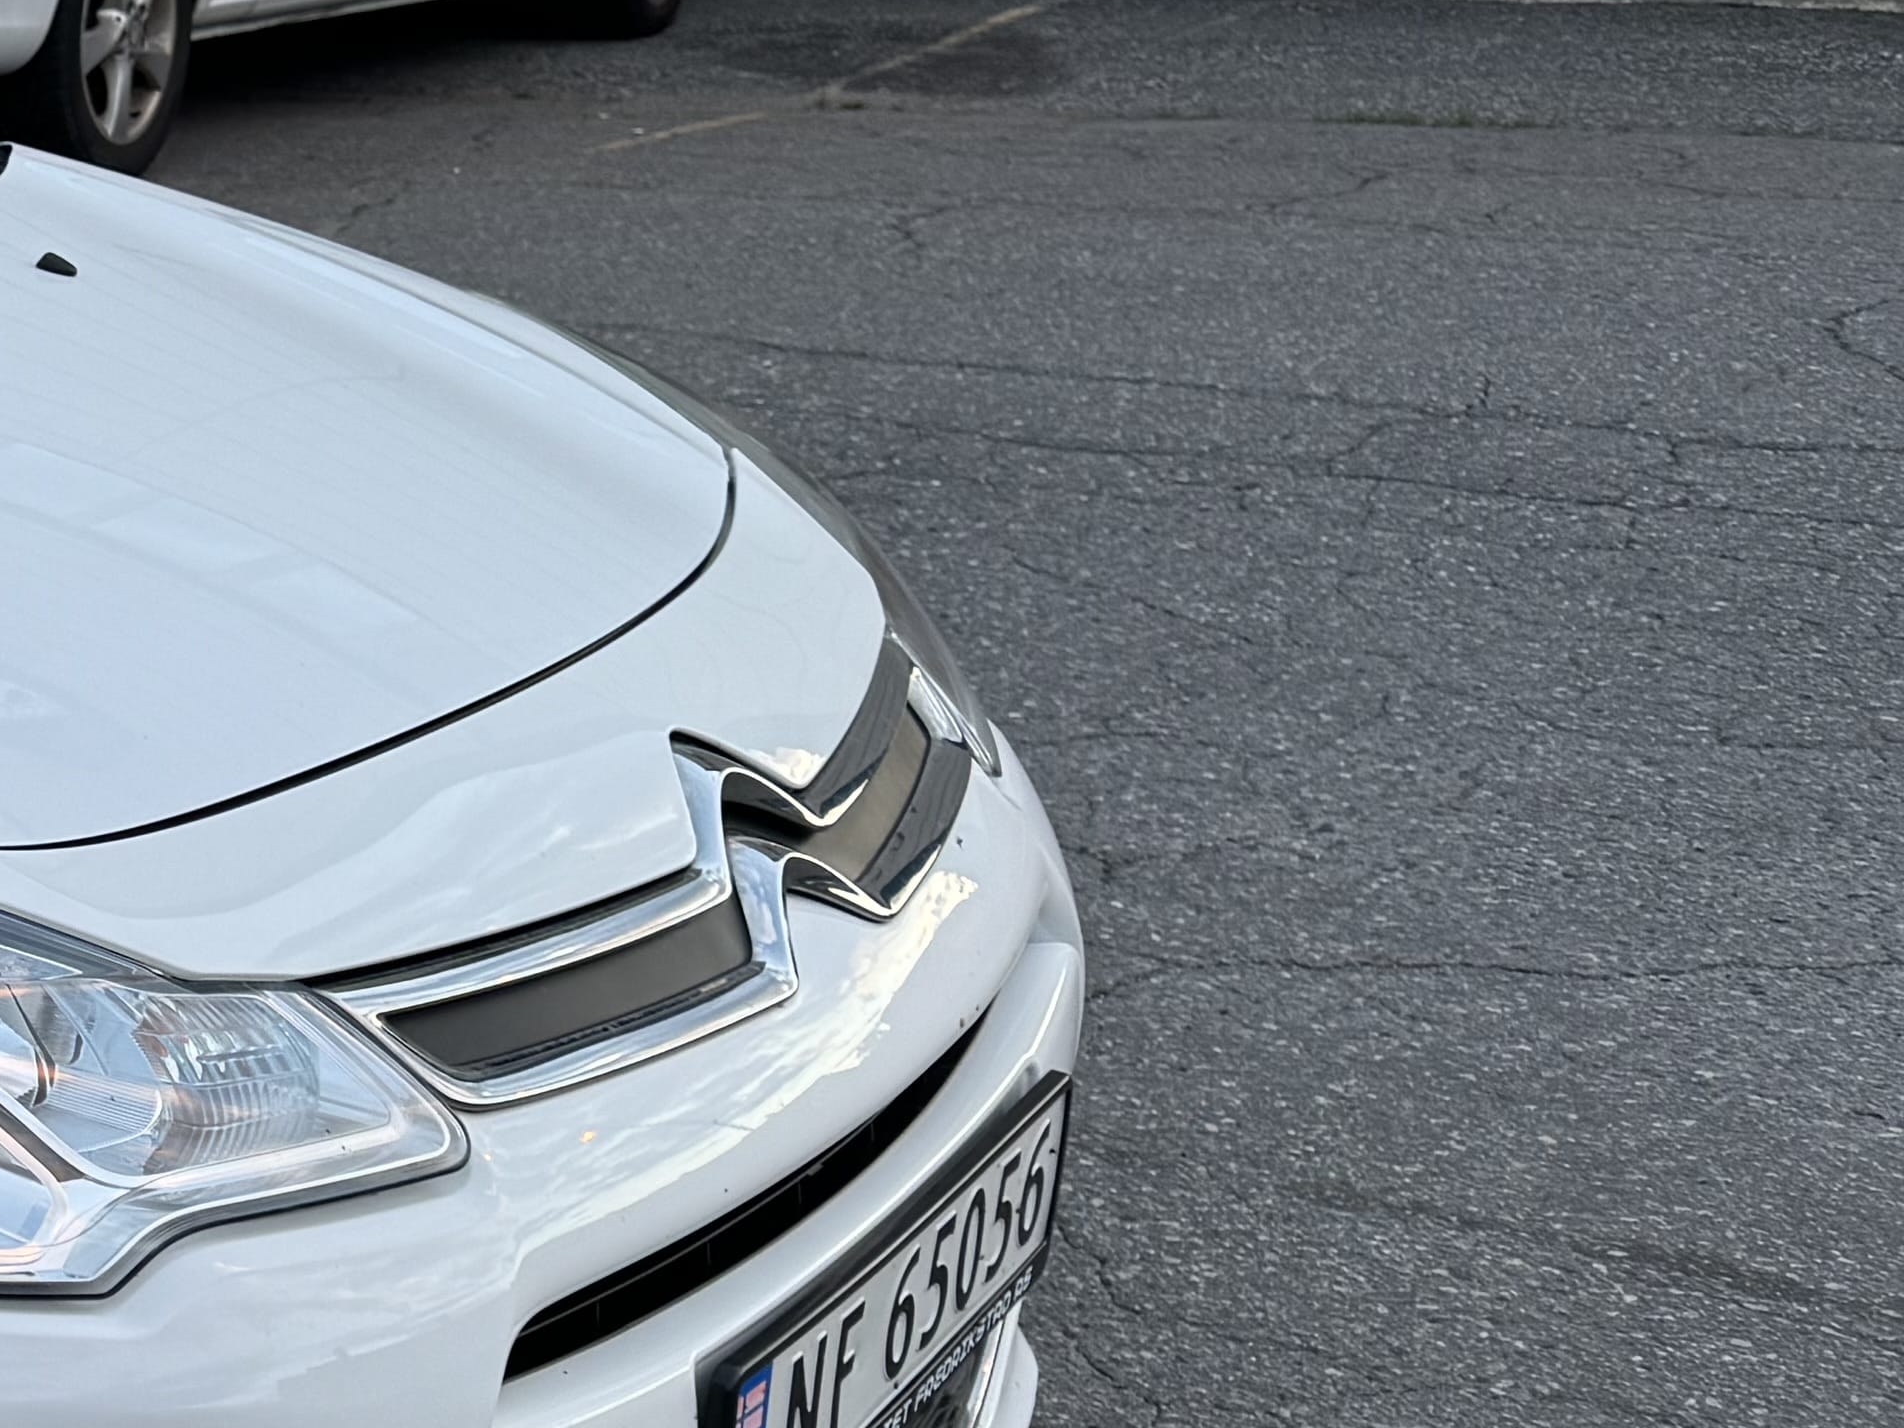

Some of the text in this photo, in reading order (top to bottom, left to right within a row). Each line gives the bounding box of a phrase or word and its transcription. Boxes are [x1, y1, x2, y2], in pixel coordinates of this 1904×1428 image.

[884, 1119, 1051, 1380] 65056
[913, 1290, 1012, 1413] FREDRIKSTAD
[1013, 1265, 1033, 1303] AS
